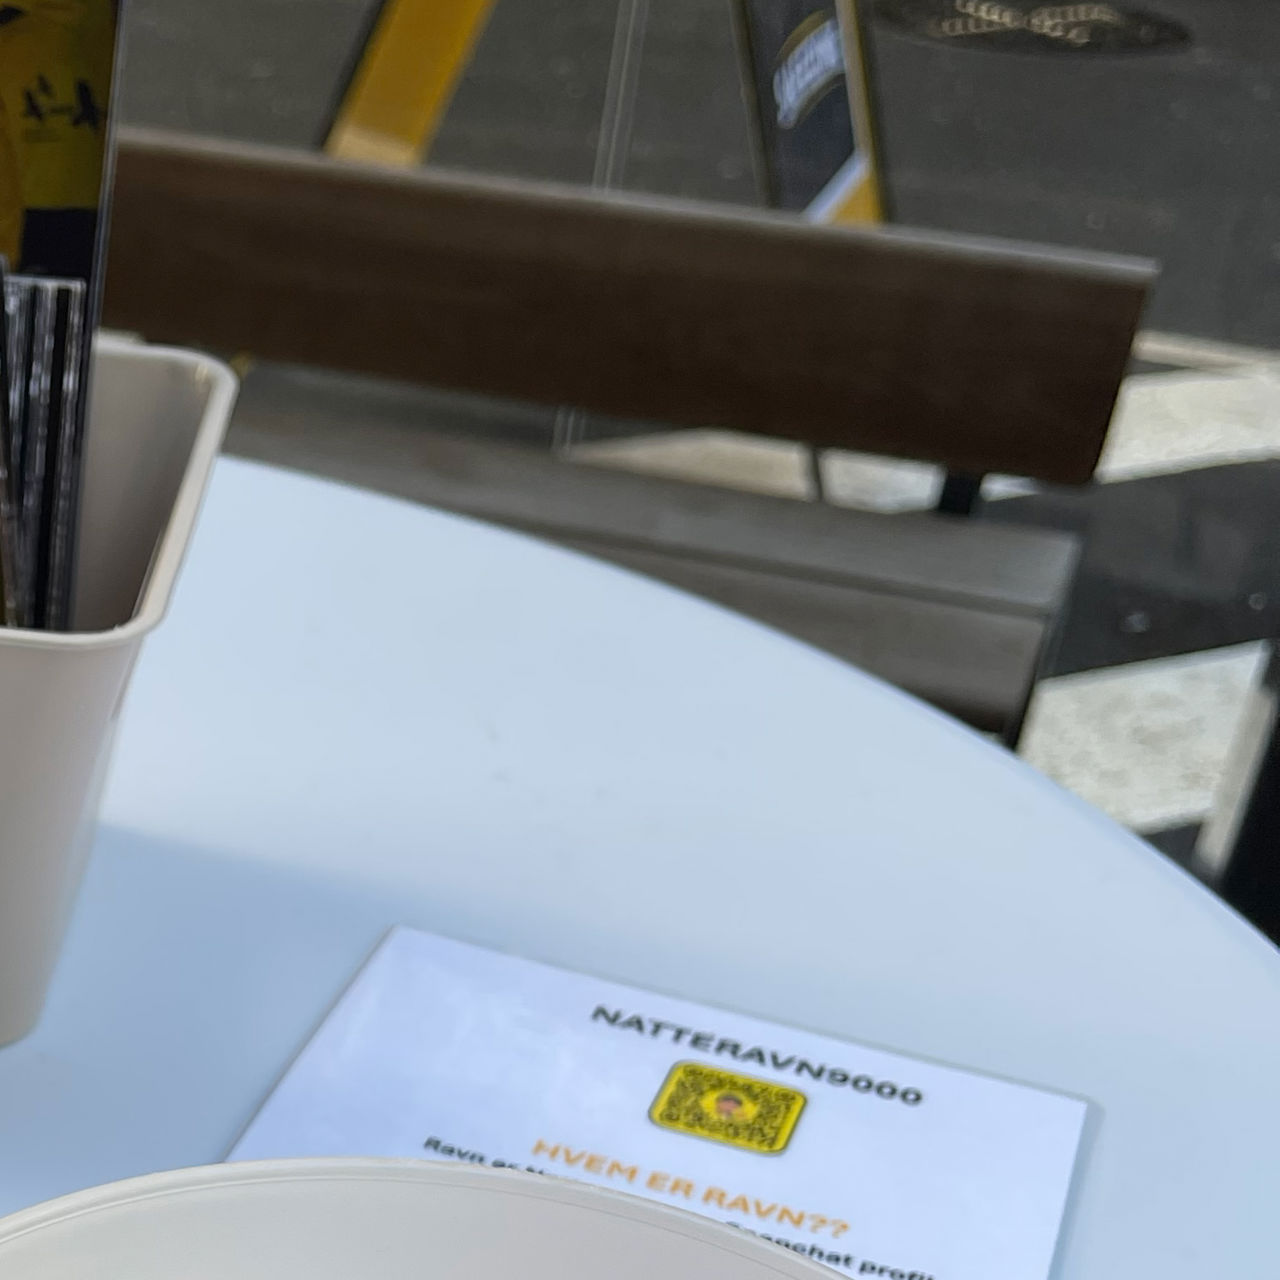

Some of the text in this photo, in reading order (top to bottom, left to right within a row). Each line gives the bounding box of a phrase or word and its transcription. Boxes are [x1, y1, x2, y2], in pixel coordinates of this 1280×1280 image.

[590, 1004, 924, 1107] NATTERAVN9000
[423, 1136, 486, 1166] Ravn
[532, 1137, 850, 1239] HVEM ER RAVN??
